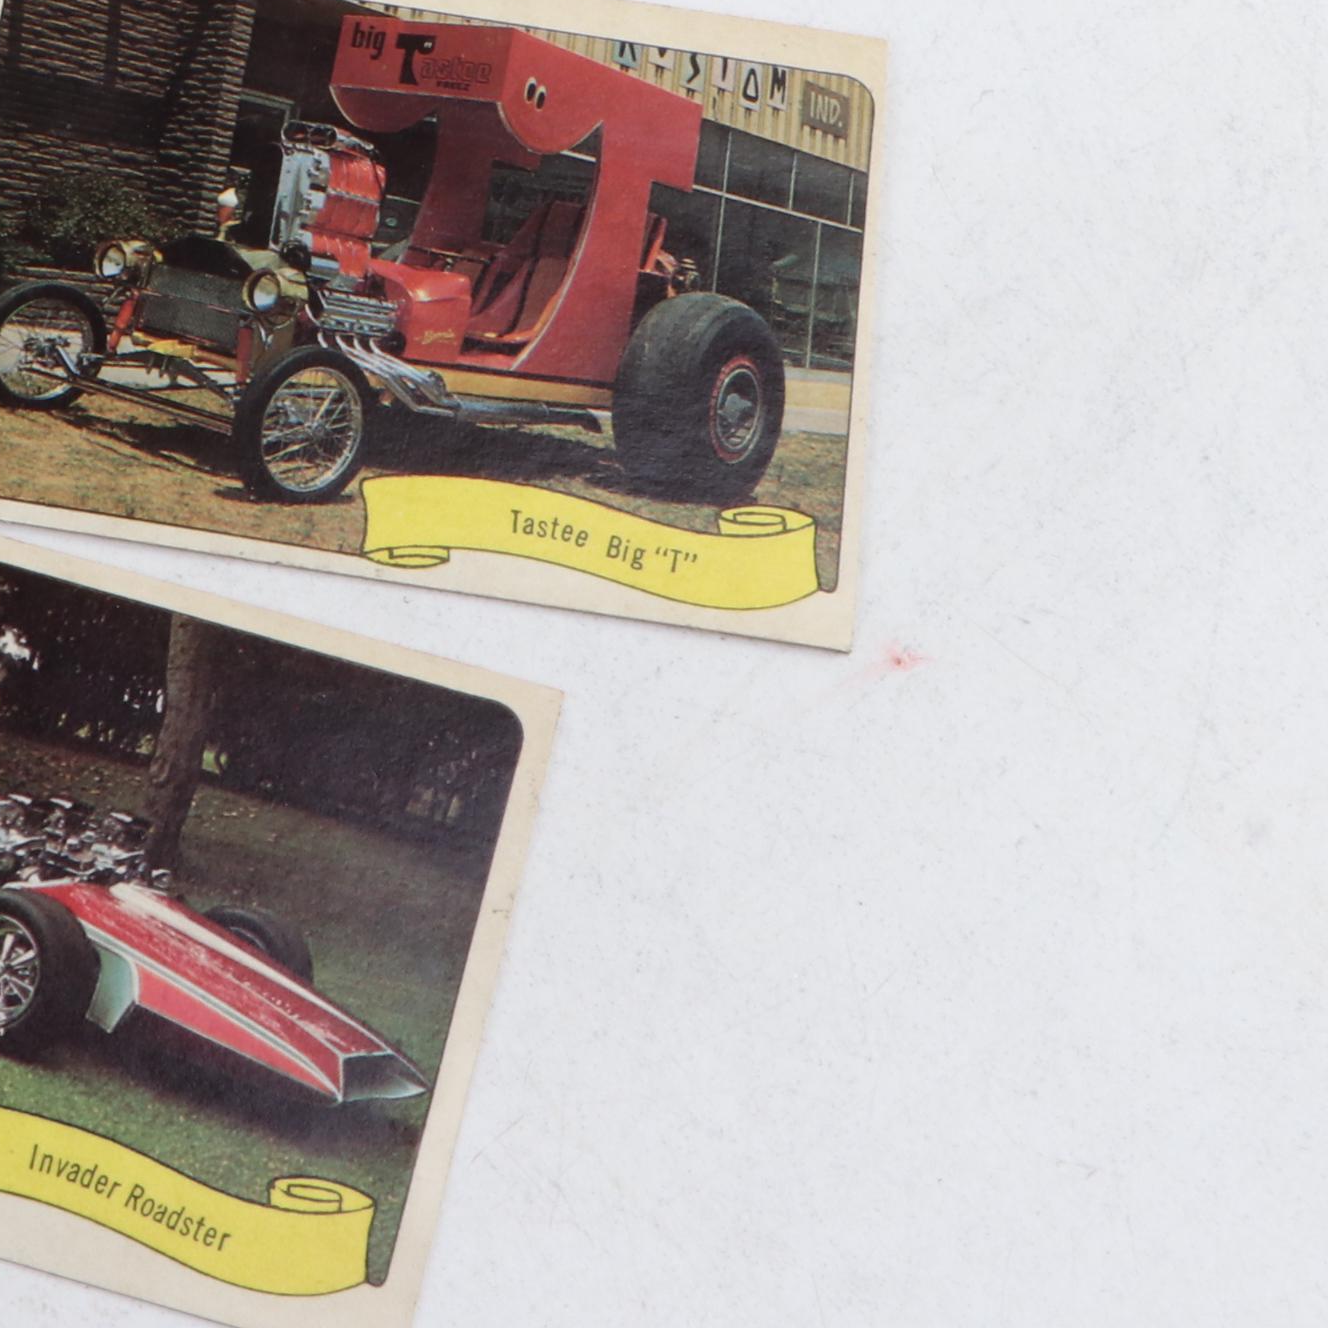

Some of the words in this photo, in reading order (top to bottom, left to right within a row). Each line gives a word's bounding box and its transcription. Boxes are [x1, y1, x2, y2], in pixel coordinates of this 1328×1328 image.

[351, 22, 386, 60] big
[809, 90, 843, 128] IND.
[509, 508, 589, 549] Tastee
[605, 534, 647, 572] Big
[28, 1142, 123, 1201] Invader
[123, 1183, 234, 1253] Roadster
